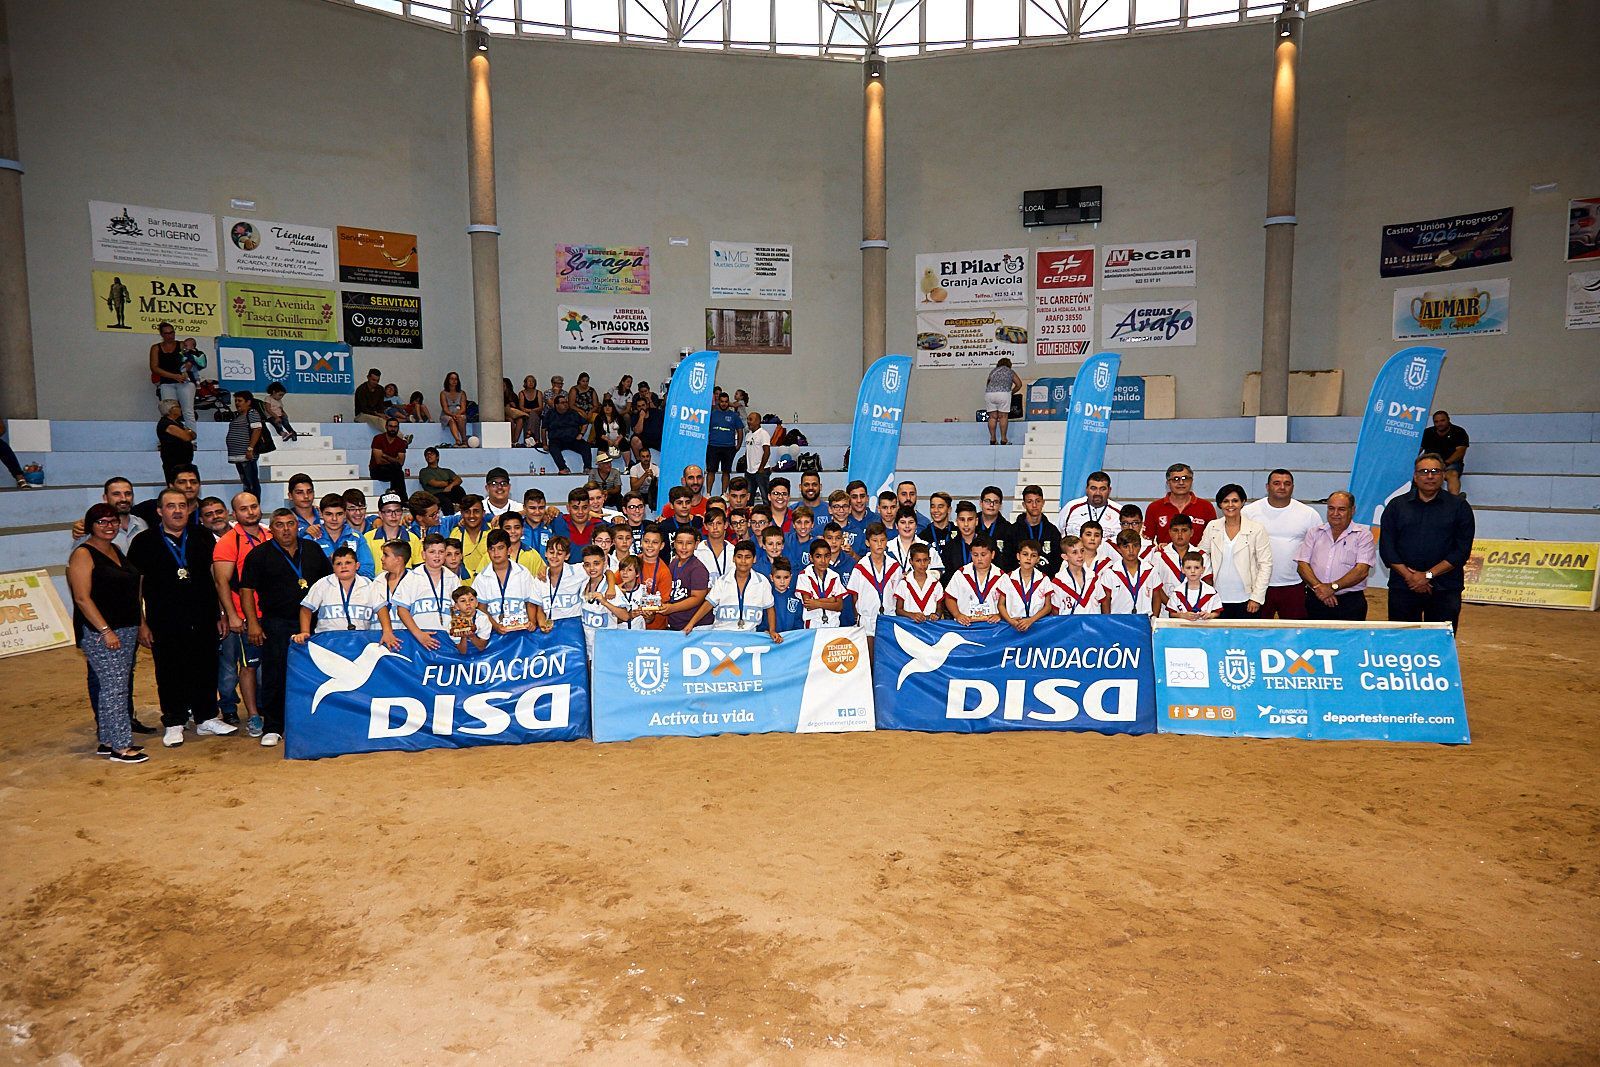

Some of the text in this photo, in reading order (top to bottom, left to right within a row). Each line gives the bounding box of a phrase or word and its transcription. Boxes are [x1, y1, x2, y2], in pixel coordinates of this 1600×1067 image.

[1025, 200, 1101, 212] LOCAL VISITANTE
[148, 218, 199, 230] Bar Restaurant
[1386, 226, 1414, 236] Casino
[1447, 221, 1454, 229] y
[148, 228, 201, 242] CHIGERNO
[270, 227, 316, 242] Técnicas
[1416, 229, 1458, 245] 1906
[289, 239, 329, 249] Alternativas
[623, 249, 645, 257] Bazar
[1107, 248, 1191, 262] Mecan
[1384, 256, 1398, 265] BAR
[1401, 253, 1433, 263] CANTINA
[560, 252, 644, 276] Soraya
[940, 259, 1002, 276] El Pilar
[940, 275, 1023, 288] Granja Avícola
[1043, 274, 1087, 284] CEPSA
[150, 280, 199, 299] BAR
[138, 295, 217, 316] MENCEY
[252, 296, 316, 311] Bar Avenida
[370, 296, 419, 308] SERVITAXI
[1422, 298, 1480, 319] ALMAR
[244, 311, 324, 326] Tasca Guillermo
[1045, 313, 1083, 322] ARAFO 38550
[1137, 308, 1174, 317] GRUAS
[185, 325, 201, 333] 022
[367, 317, 419, 328] 922 37 89 99
[589, 320, 650, 332] PITAGORAS
[1041, 324, 1086, 334] 922 523 000
[1110, 308, 1194, 341] Arafo
[365, 326, 376, 335] De
[1037, 342, 1079, 355] FUMERGAS
[294, 349, 350, 372] DXT
[295, 371, 352, 384] TENERIFE
[680, 406, 709, 424] DXT
[872, 405, 902, 421] DXT
[1084, 402, 1112, 420] DXT
[1388, 401, 1427, 422] DXT
[871, 420, 895, 428] DEPORTES
[1384, 425, 1420, 438] DE TENERIFE
[1385, 419, 1415, 430] DEPORTES
[1487, 551, 1590, 568] CASA JUAN
[826, 643, 853, 651] TENERIFE
[828, 649, 853, 658] JUEGA
[682, 645, 771, 677] DXT
[826, 655, 855, 664] LIMPIO
[999, 642, 1141, 669] FUNDACIÓN
[1260, 648, 1340, 675] DXT
[1358, 649, 1442, 669] Juegos
[421, 650, 567, 687] FUNDACIÓN
[1170, 667, 1205, 684] 2030
[682, 679, 764, 695] TENERIFE
[1263, 676, 1344, 691] TENERIFE
[1360, 672, 1451, 692] Cabildo
[648, 709, 755, 727] Activa tu vida
[1322, 711, 1456, 725] deportestenerife.com
